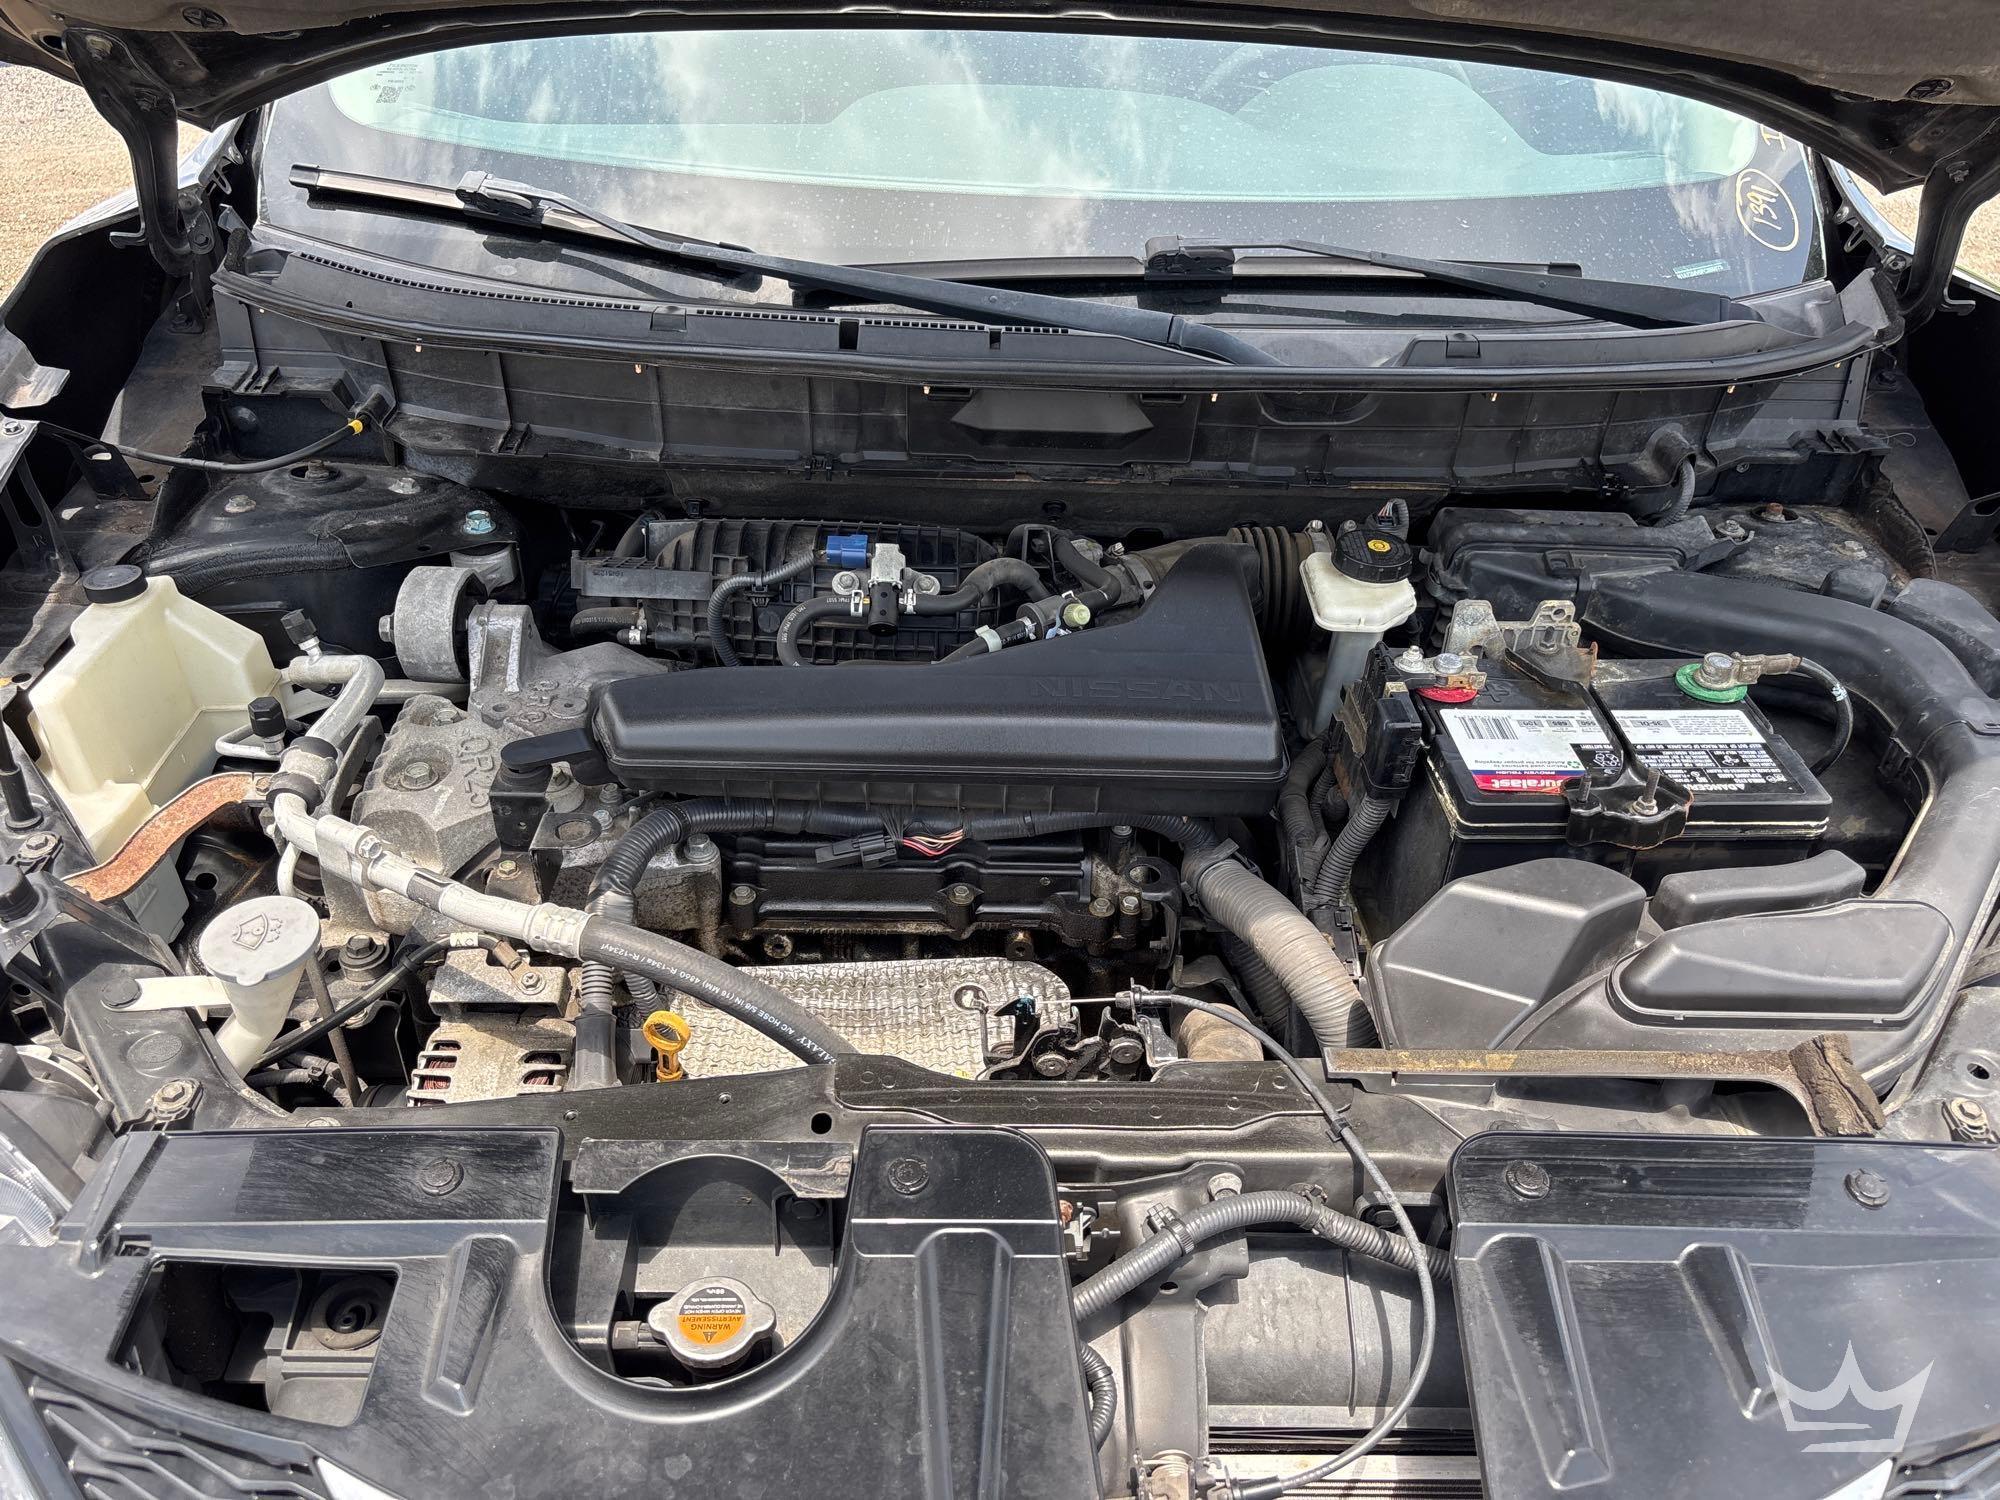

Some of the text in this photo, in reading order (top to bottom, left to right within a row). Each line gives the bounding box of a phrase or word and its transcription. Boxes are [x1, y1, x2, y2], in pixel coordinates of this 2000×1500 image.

[1746, 185, 1782, 231] 1391
[1031, 676, 1241, 703] NISSAN
[599, 943, 641, 962] R-1234yf
[646, 957, 678, 975] R-134a
[679, 970, 701, 984] 4860
[702, 980, 721, 994] MM)
[720, 989, 736, 1002] (16
[734, 996, 744, 1007] IN
[744, 1003, 759, 1016] 5/8
[756, 1009, 782, 1027] HOSE
[781, 1023, 796, 1036] A/C
[682, 1315, 742, 1323] AVERTISSEMENT
[690, 1323, 731, 1331] WARNING
